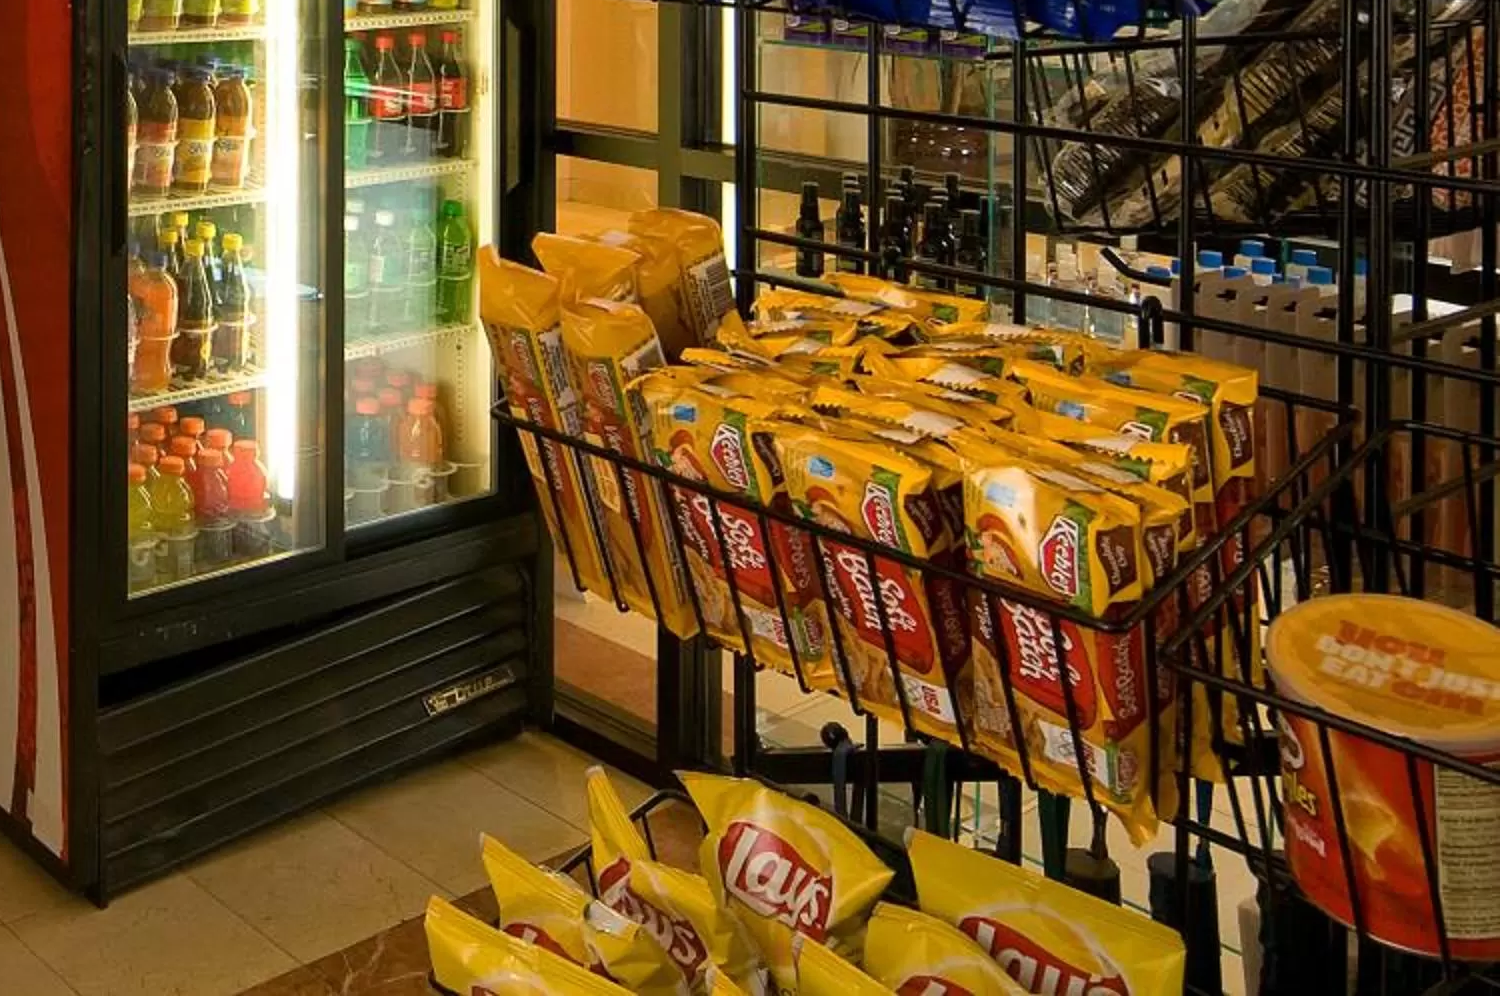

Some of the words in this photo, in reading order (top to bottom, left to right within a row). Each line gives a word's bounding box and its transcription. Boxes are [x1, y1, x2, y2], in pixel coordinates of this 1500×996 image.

[716, 423, 749, 489] Keebler
[1051, 517, 1079, 597] Keebler
[876, 573, 917, 634] Soft
